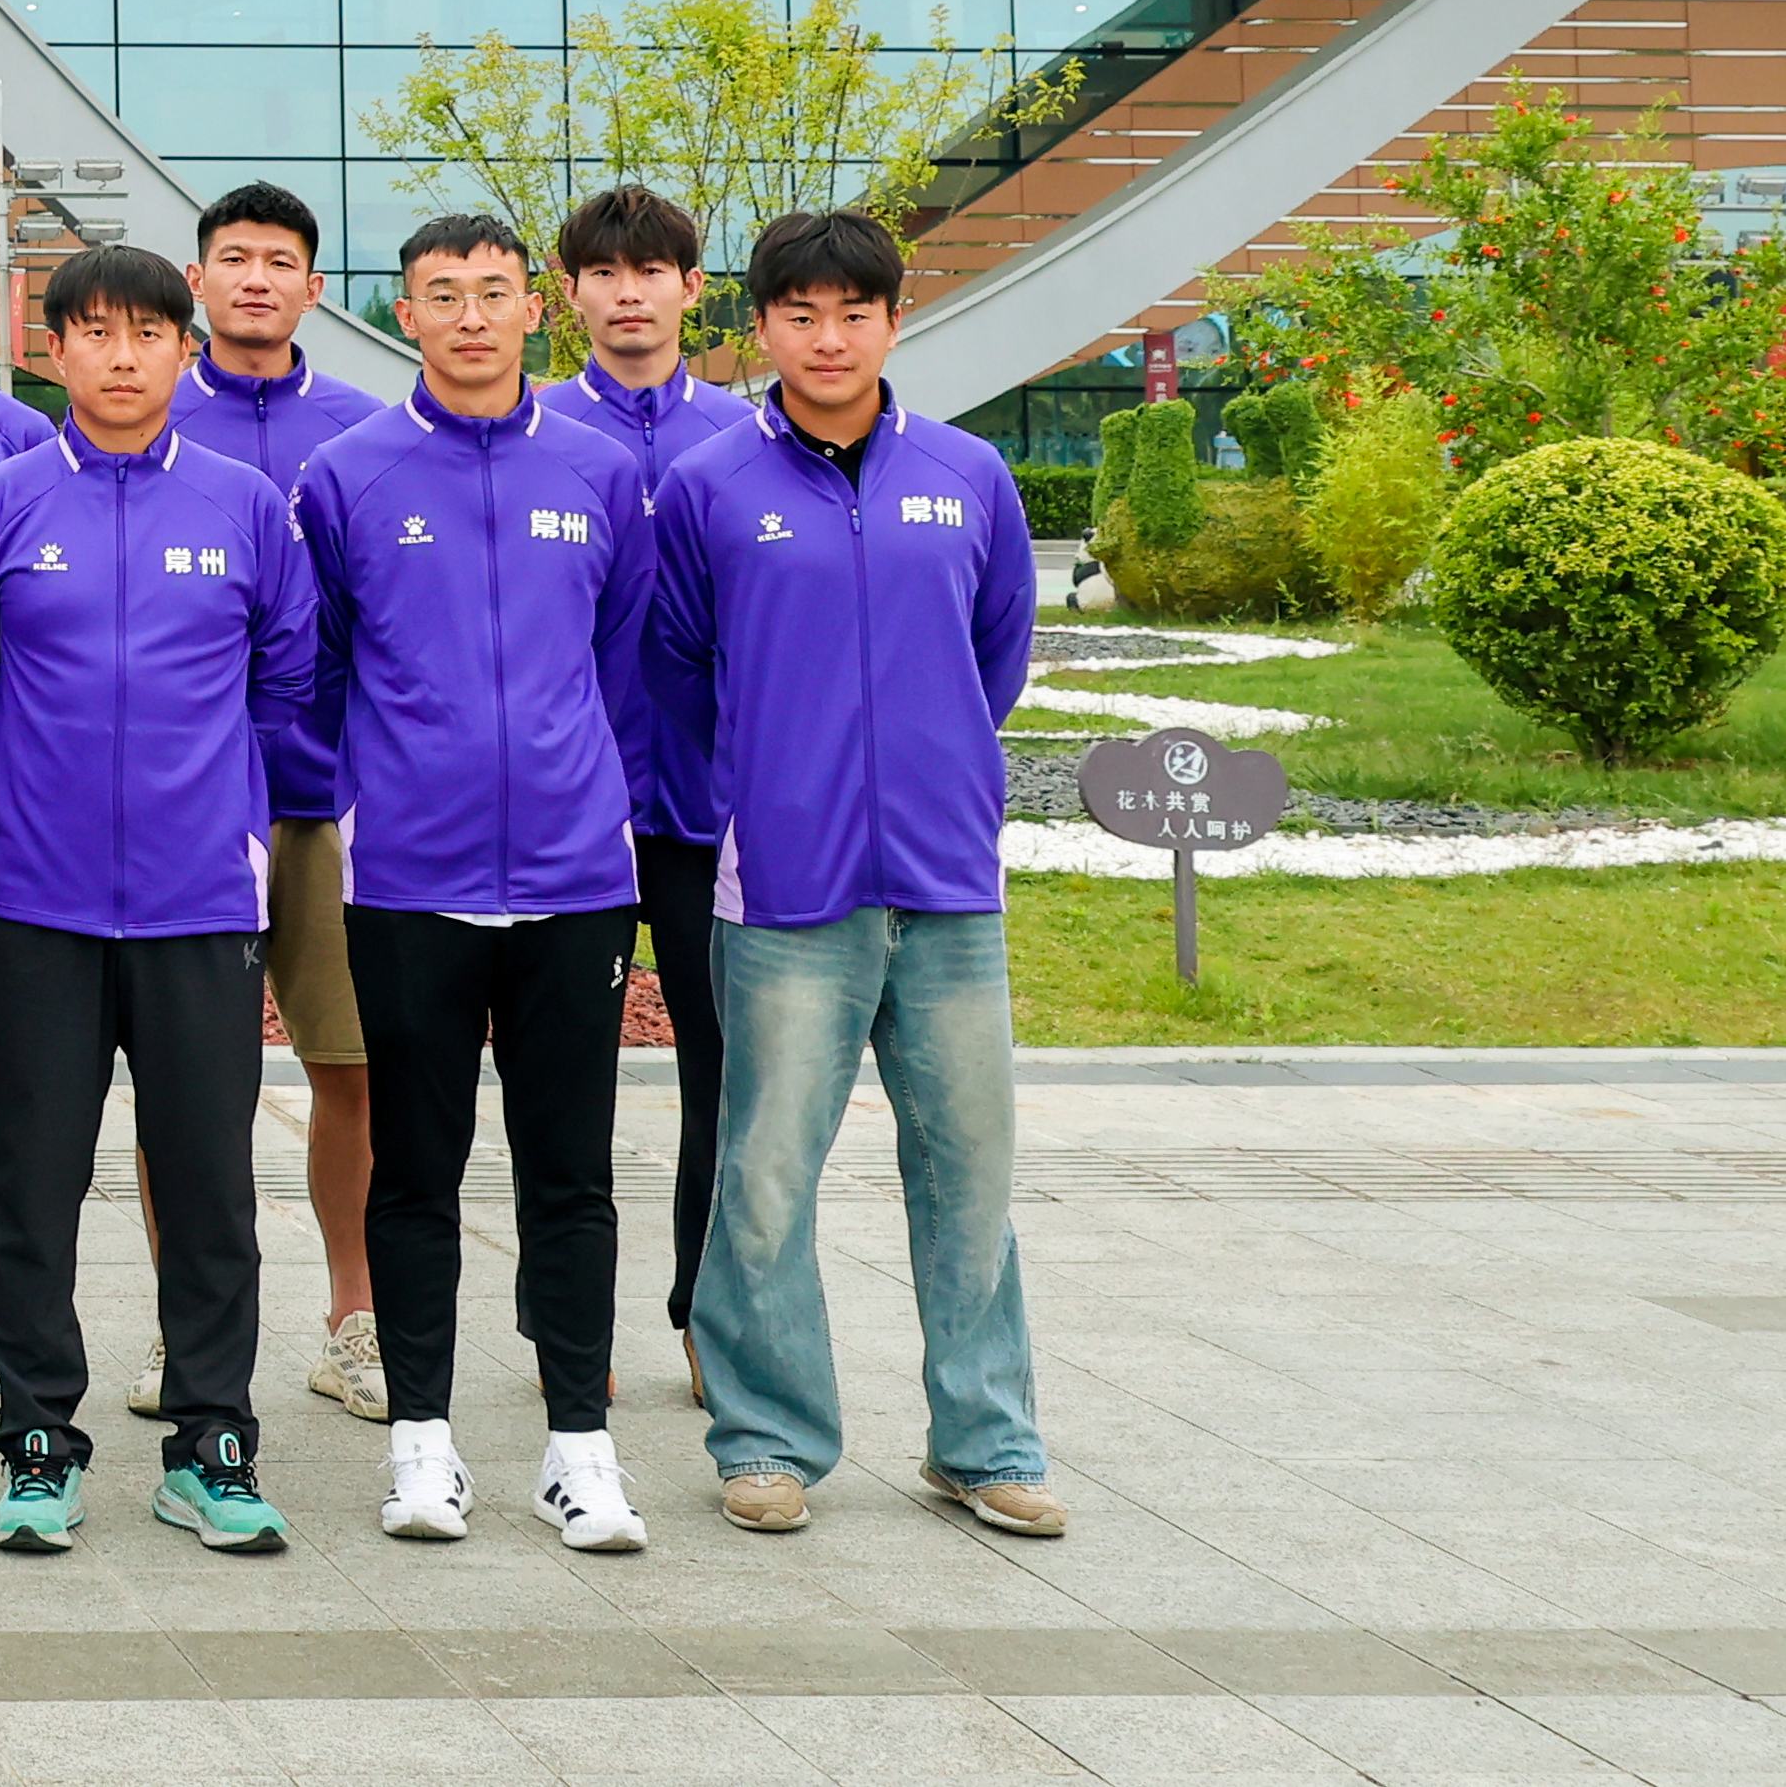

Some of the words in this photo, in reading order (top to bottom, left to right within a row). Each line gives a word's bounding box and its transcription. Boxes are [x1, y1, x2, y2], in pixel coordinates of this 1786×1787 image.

[900, 496, 962, 527] 常州
[530, 509, 587, 544] 常州
[757, 530, 794, 542] KELME
[398, 534, 434, 544] KELME
[33, 563, 68, 571] KELME
[164, 547, 225, 576] 常州
[1116, 790, 1211, 813] 花木共赏
[1158, 818, 1252, 841] 人人呵护
